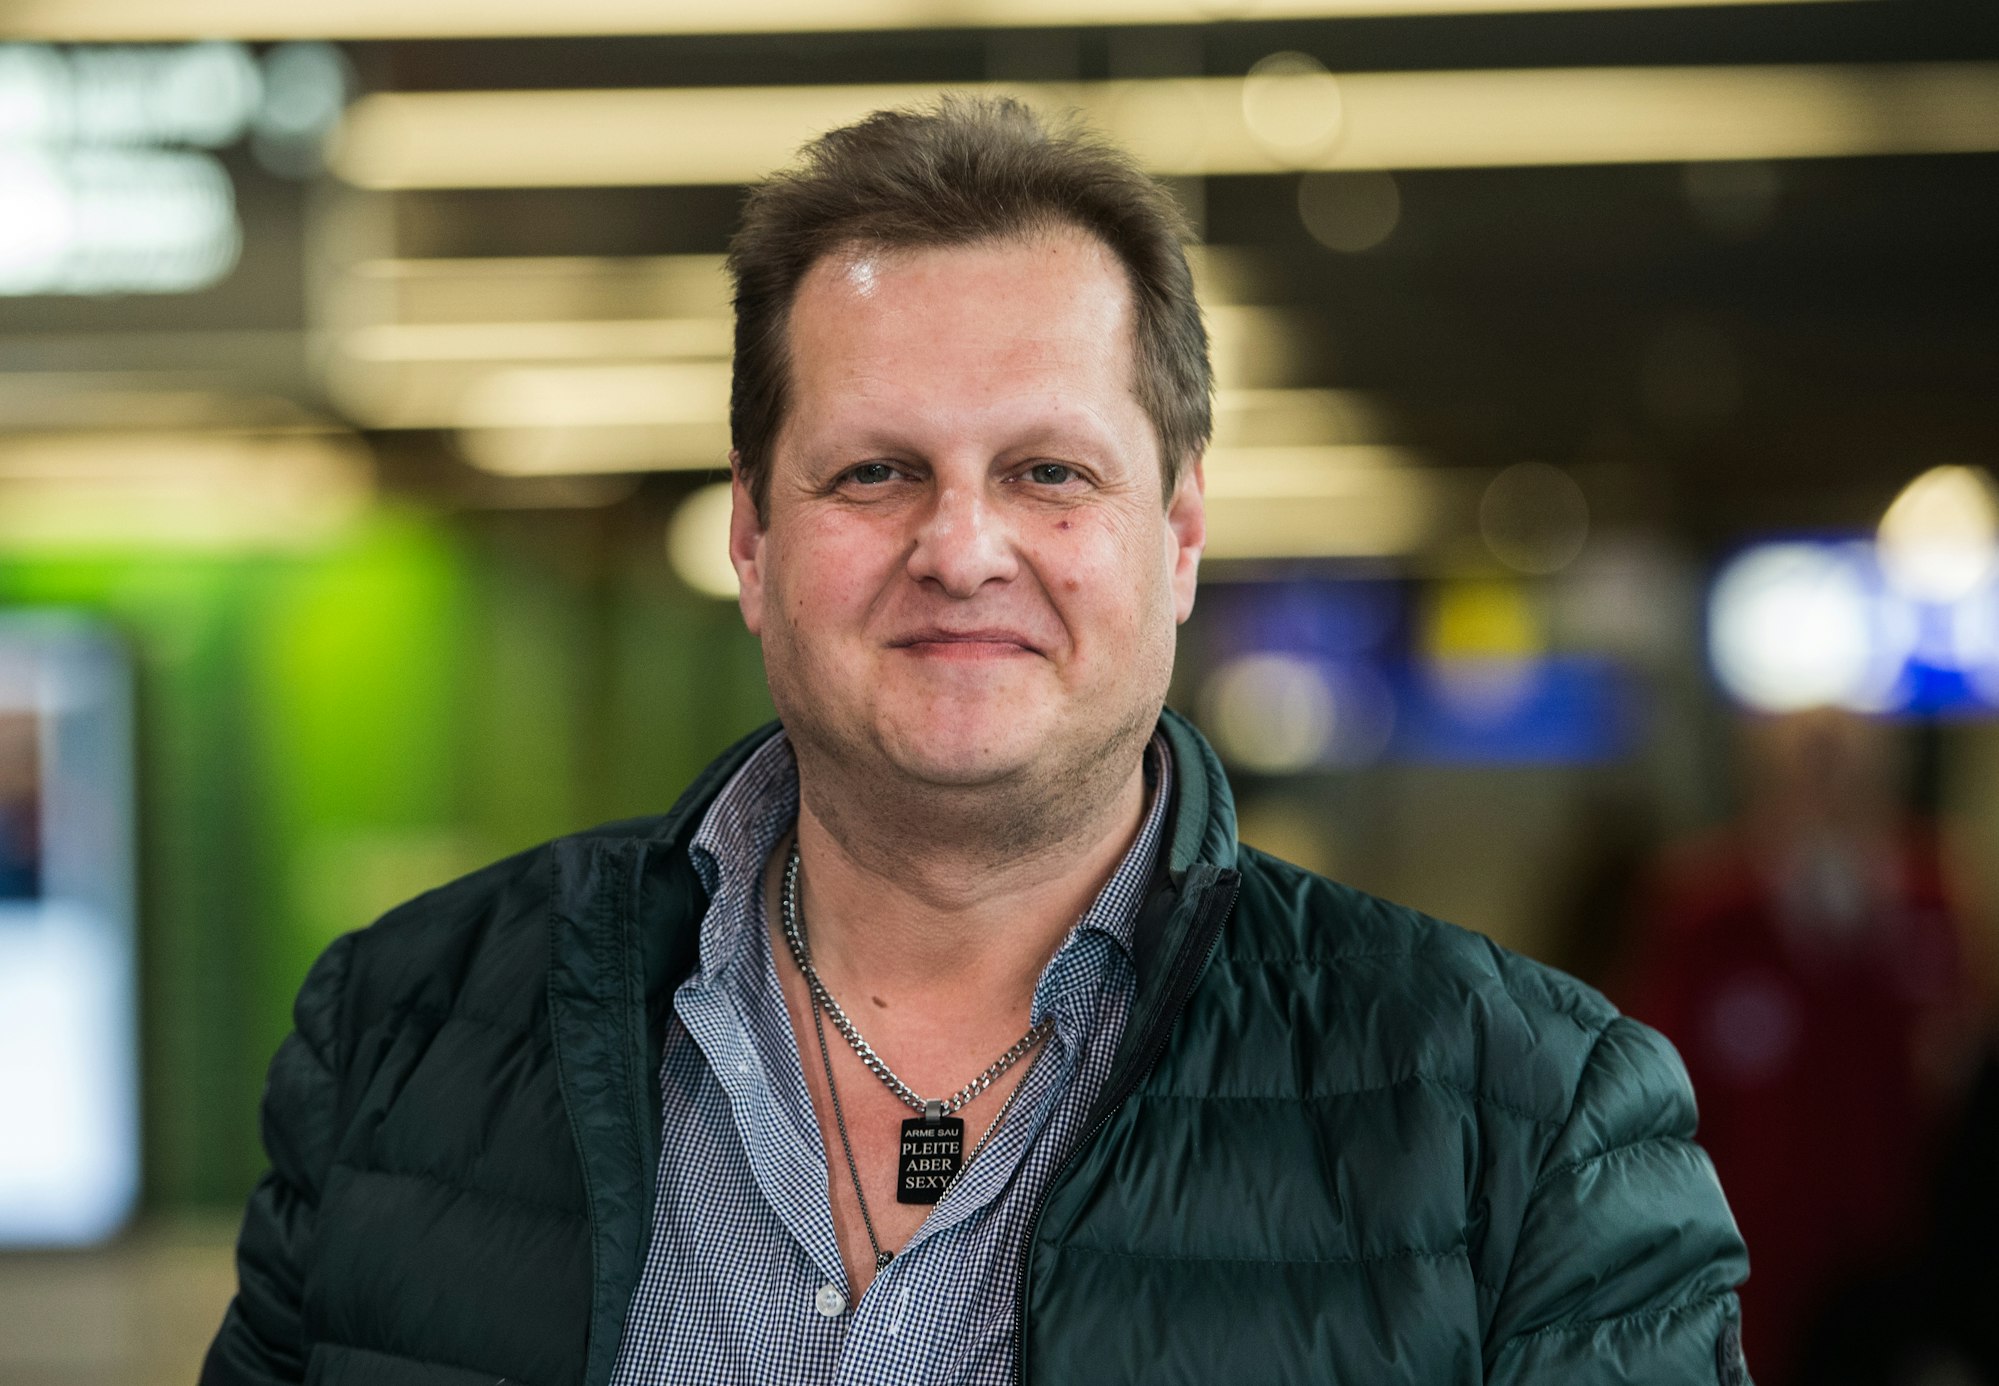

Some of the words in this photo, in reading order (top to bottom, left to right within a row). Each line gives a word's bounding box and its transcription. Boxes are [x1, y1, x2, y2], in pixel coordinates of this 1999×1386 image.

[905, 1129, 935, 1137] ARME
[937, 1129, 959, 1137] SAU
[902, 1141, 960, 1155] PLEITE
[906, 1158, 952, 1171] ABER
[905, 1176, 951, 1189] SEXY
